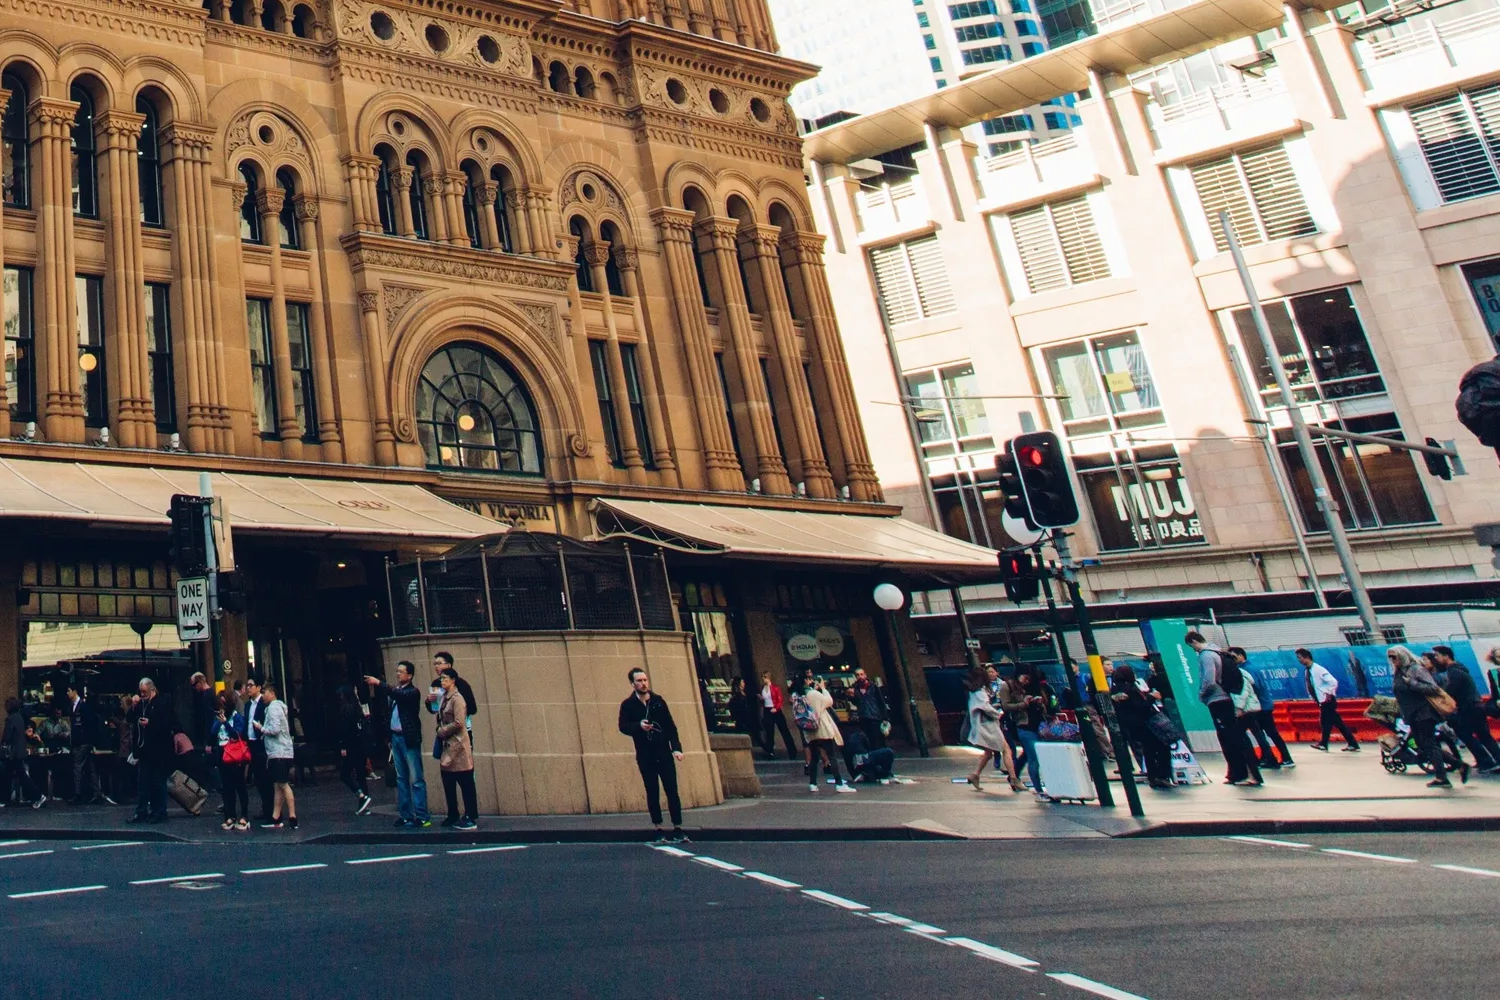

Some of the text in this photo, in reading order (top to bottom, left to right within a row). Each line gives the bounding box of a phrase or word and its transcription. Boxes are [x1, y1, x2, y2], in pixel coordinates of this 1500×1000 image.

[181, 584, 202, 598] ONE
[181, 602, 203, 617] WAY
[1268, 669, 1289, 679] TURN
[1368, 665, 1388, 677] EASY
